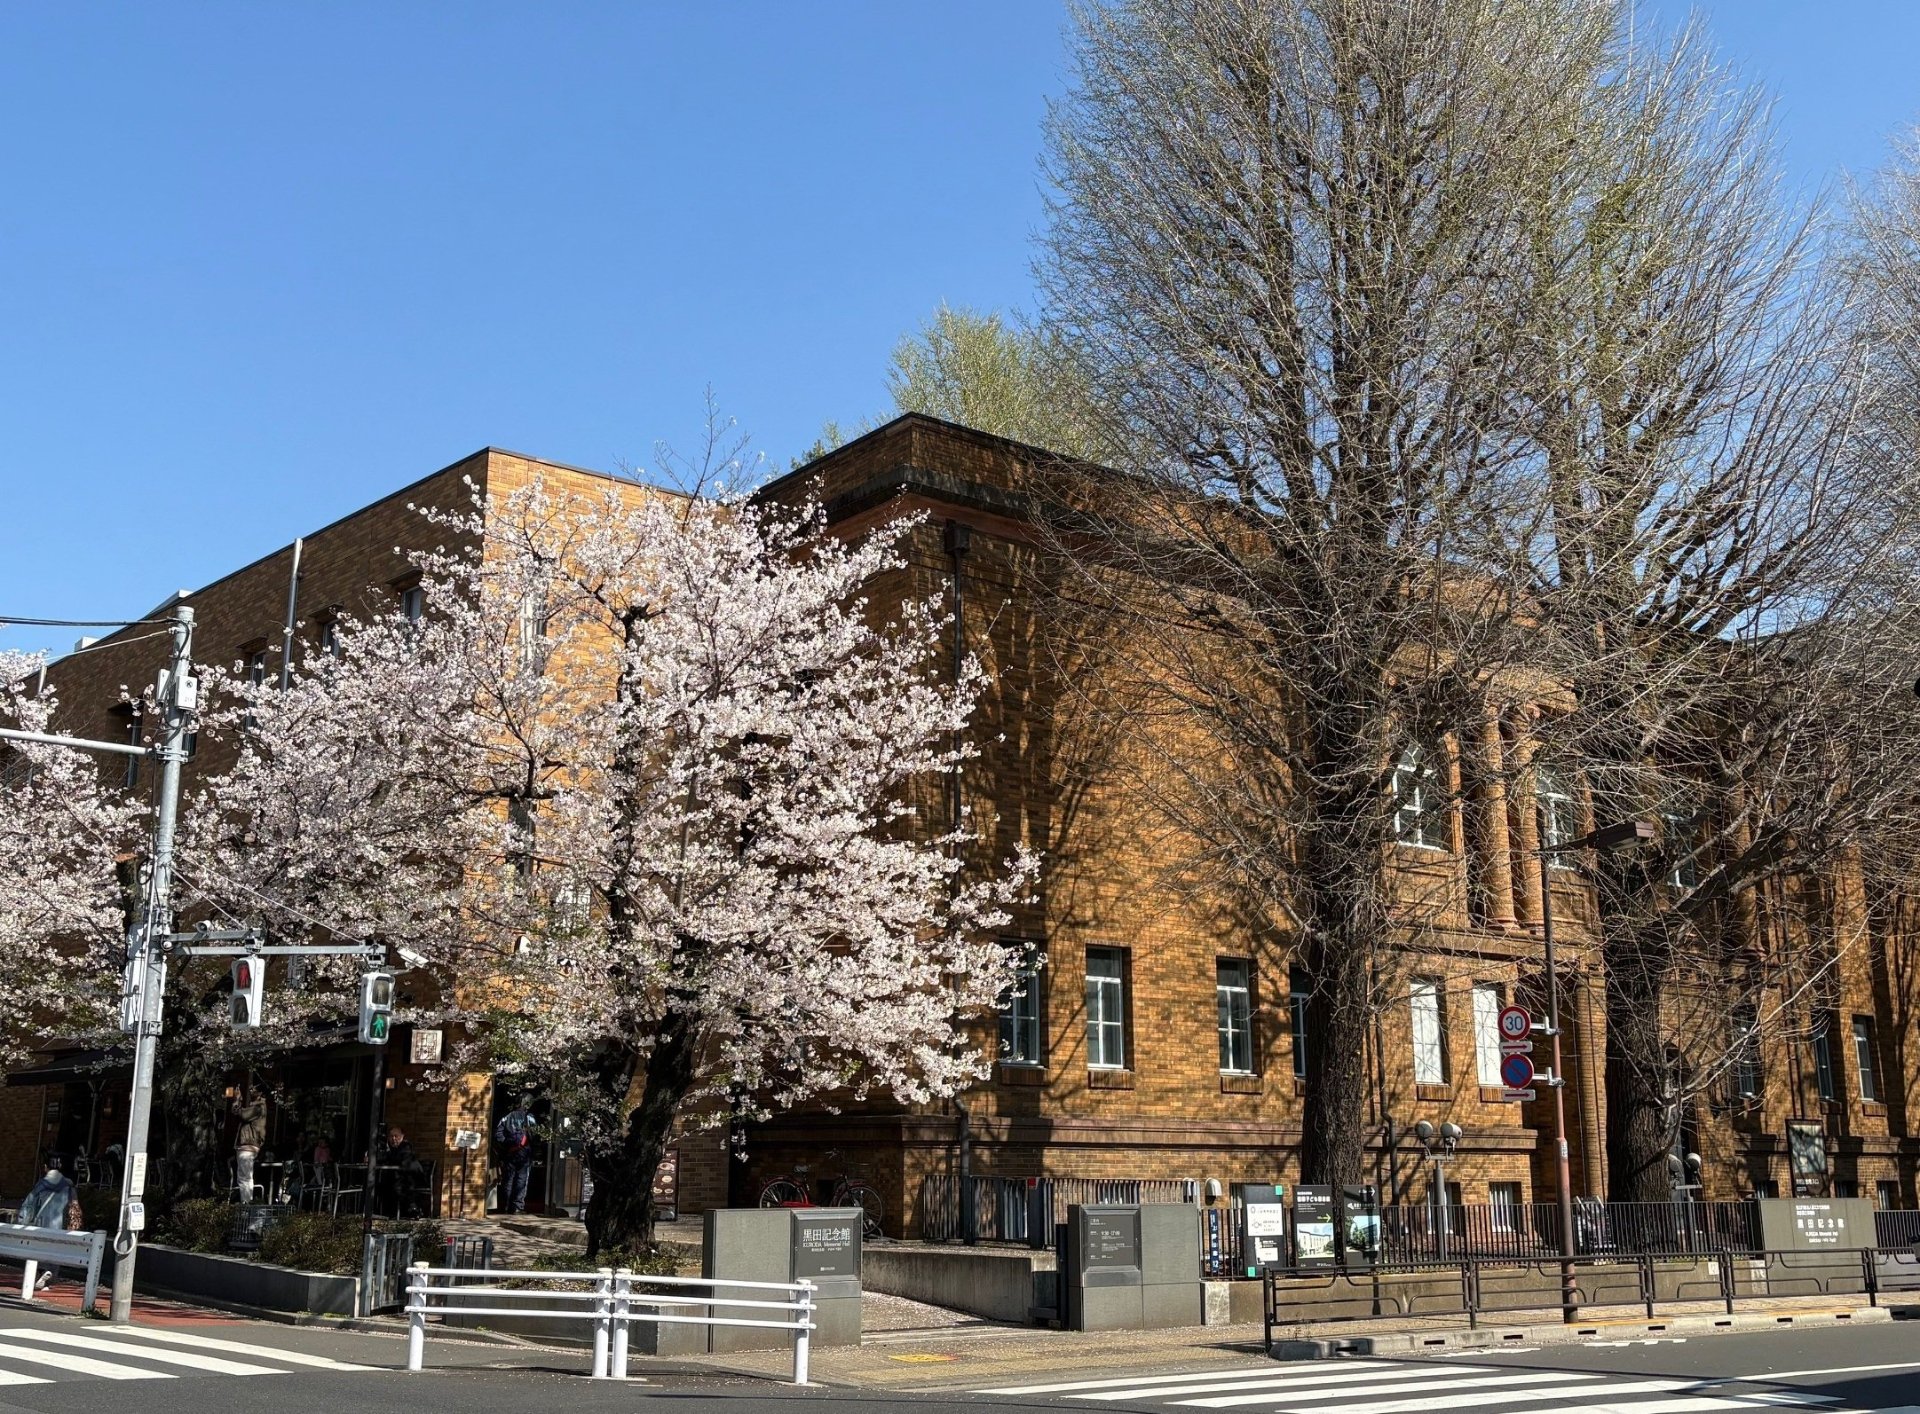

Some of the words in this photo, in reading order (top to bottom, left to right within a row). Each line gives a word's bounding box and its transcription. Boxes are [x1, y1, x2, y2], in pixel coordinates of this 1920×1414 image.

[1505, 1016, 1523, 1030] 30
[802, 1228, 850, 1241] 黒田記念館
